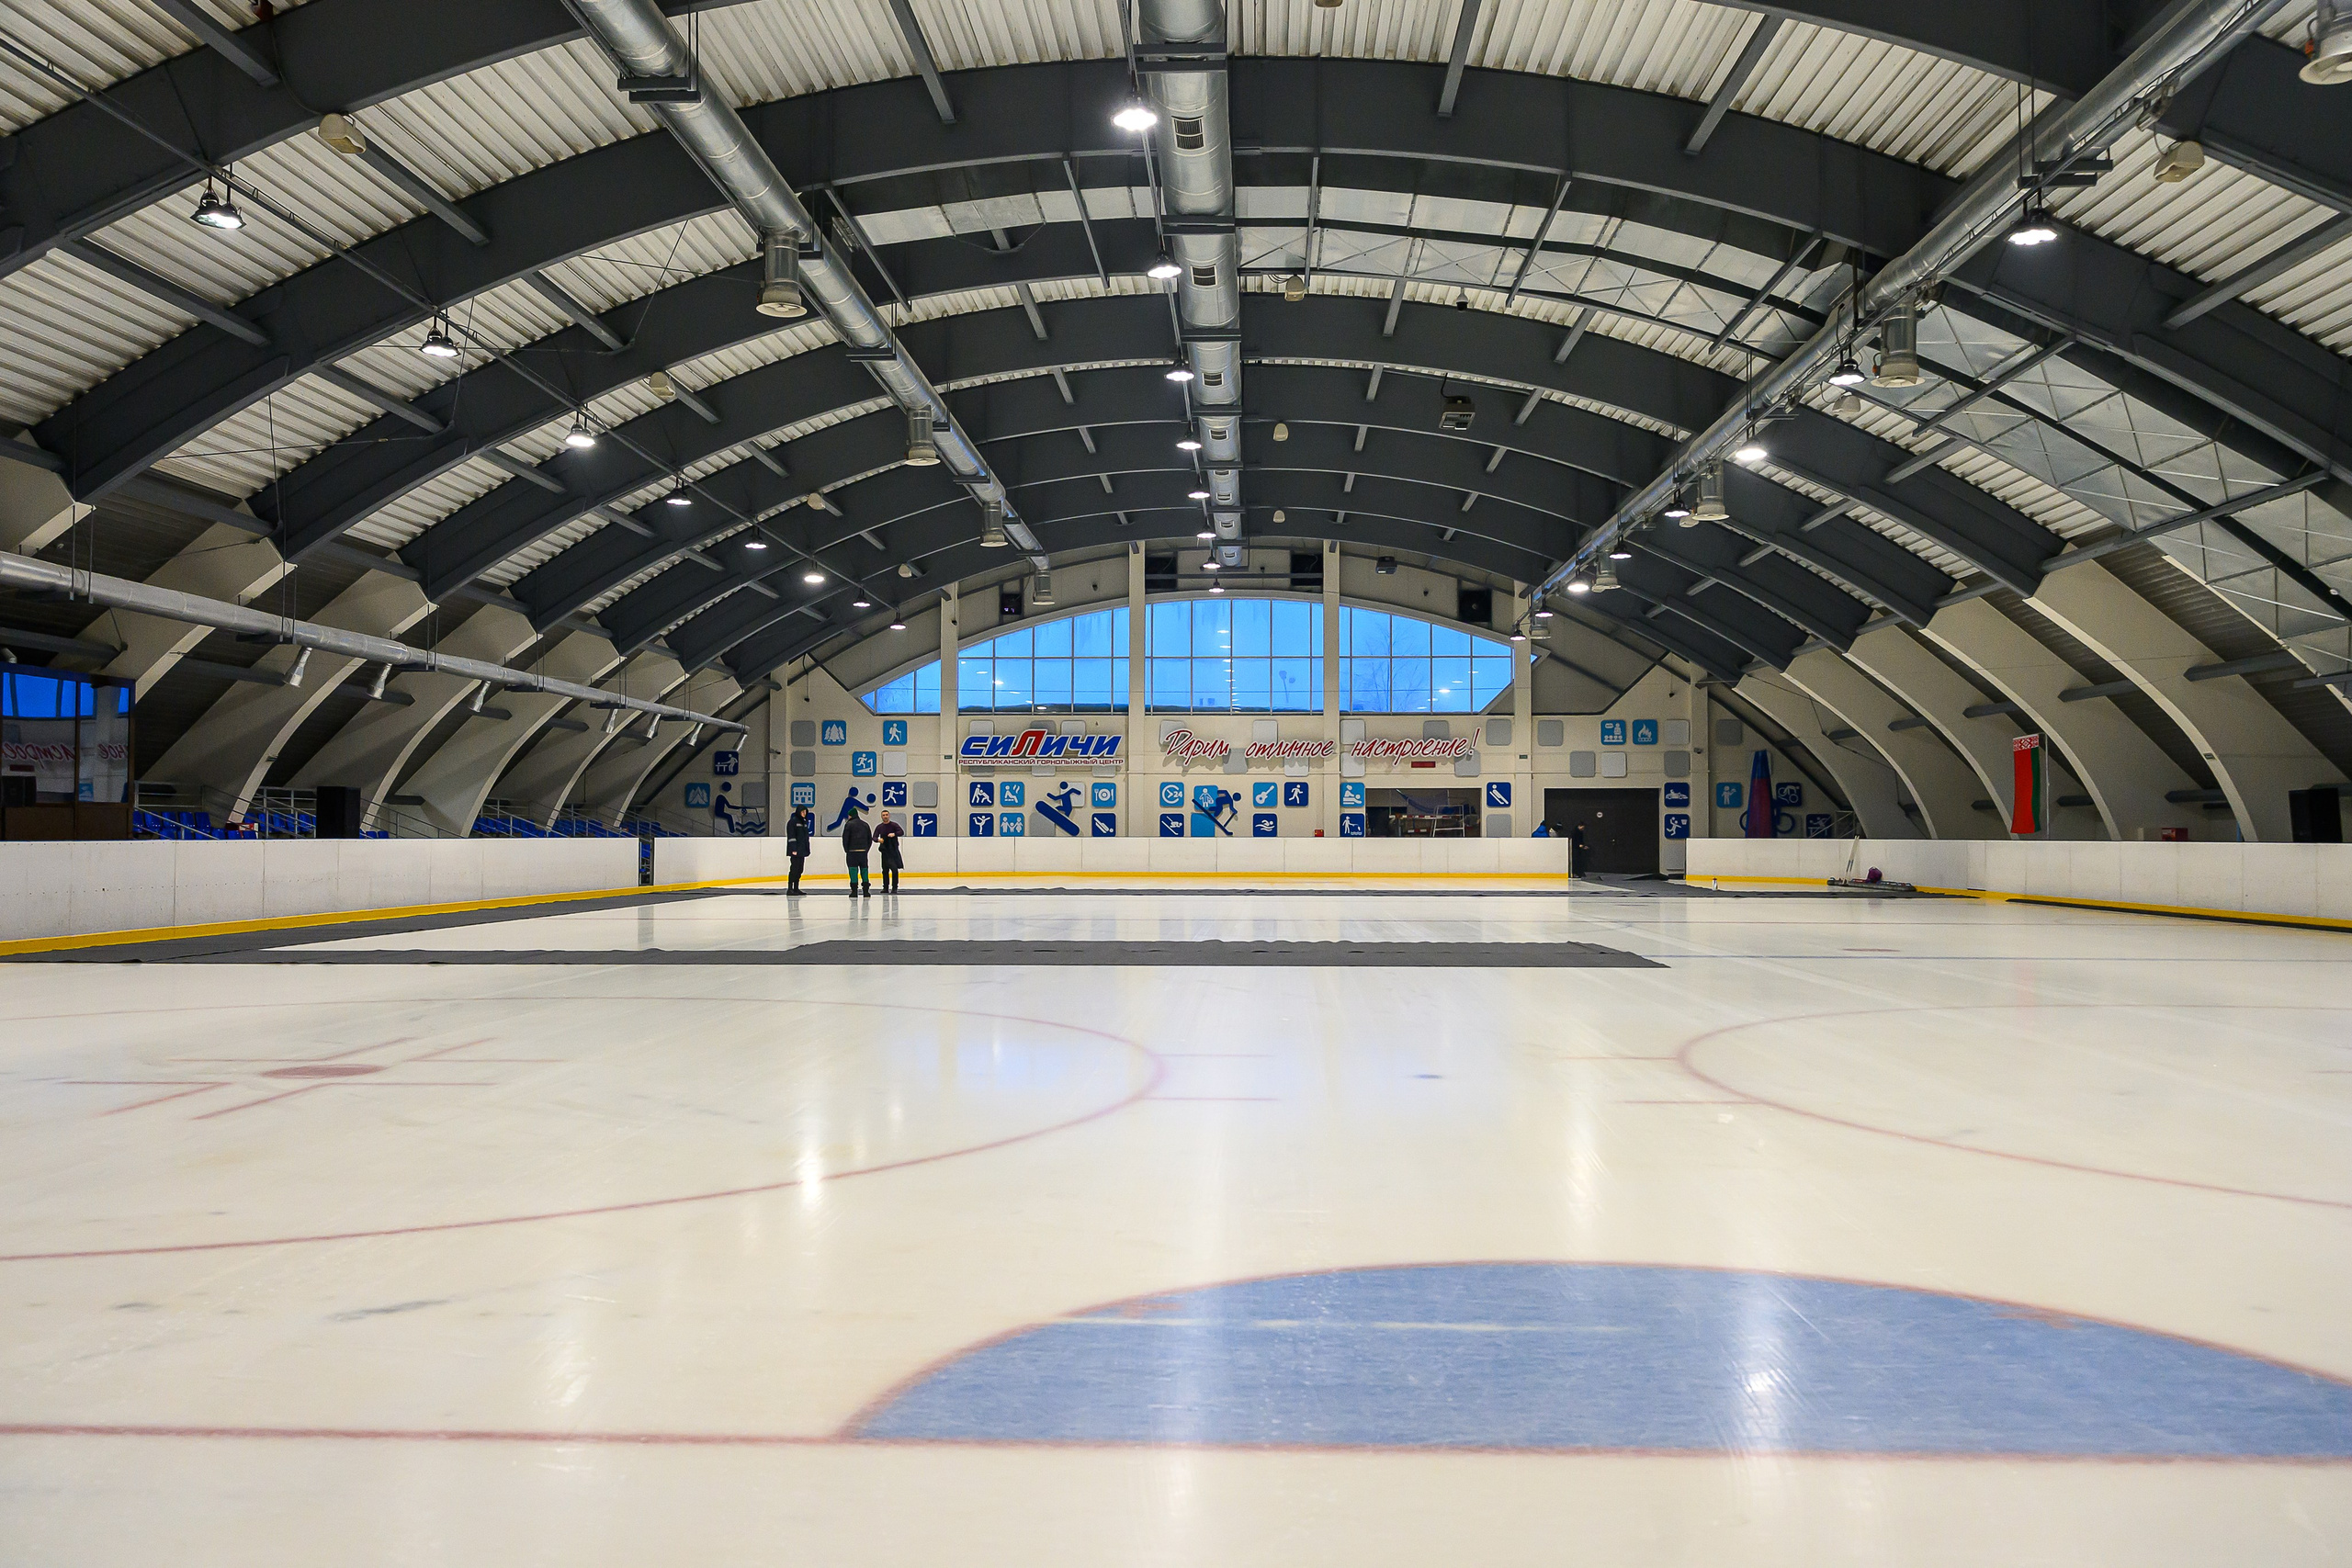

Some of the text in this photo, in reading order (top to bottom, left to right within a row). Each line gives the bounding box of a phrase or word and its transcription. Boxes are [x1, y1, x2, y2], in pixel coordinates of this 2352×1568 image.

[1165, 728, 1481, 765] Дарим отличное настроение!
[1173, 790, 1183, 798] 24
